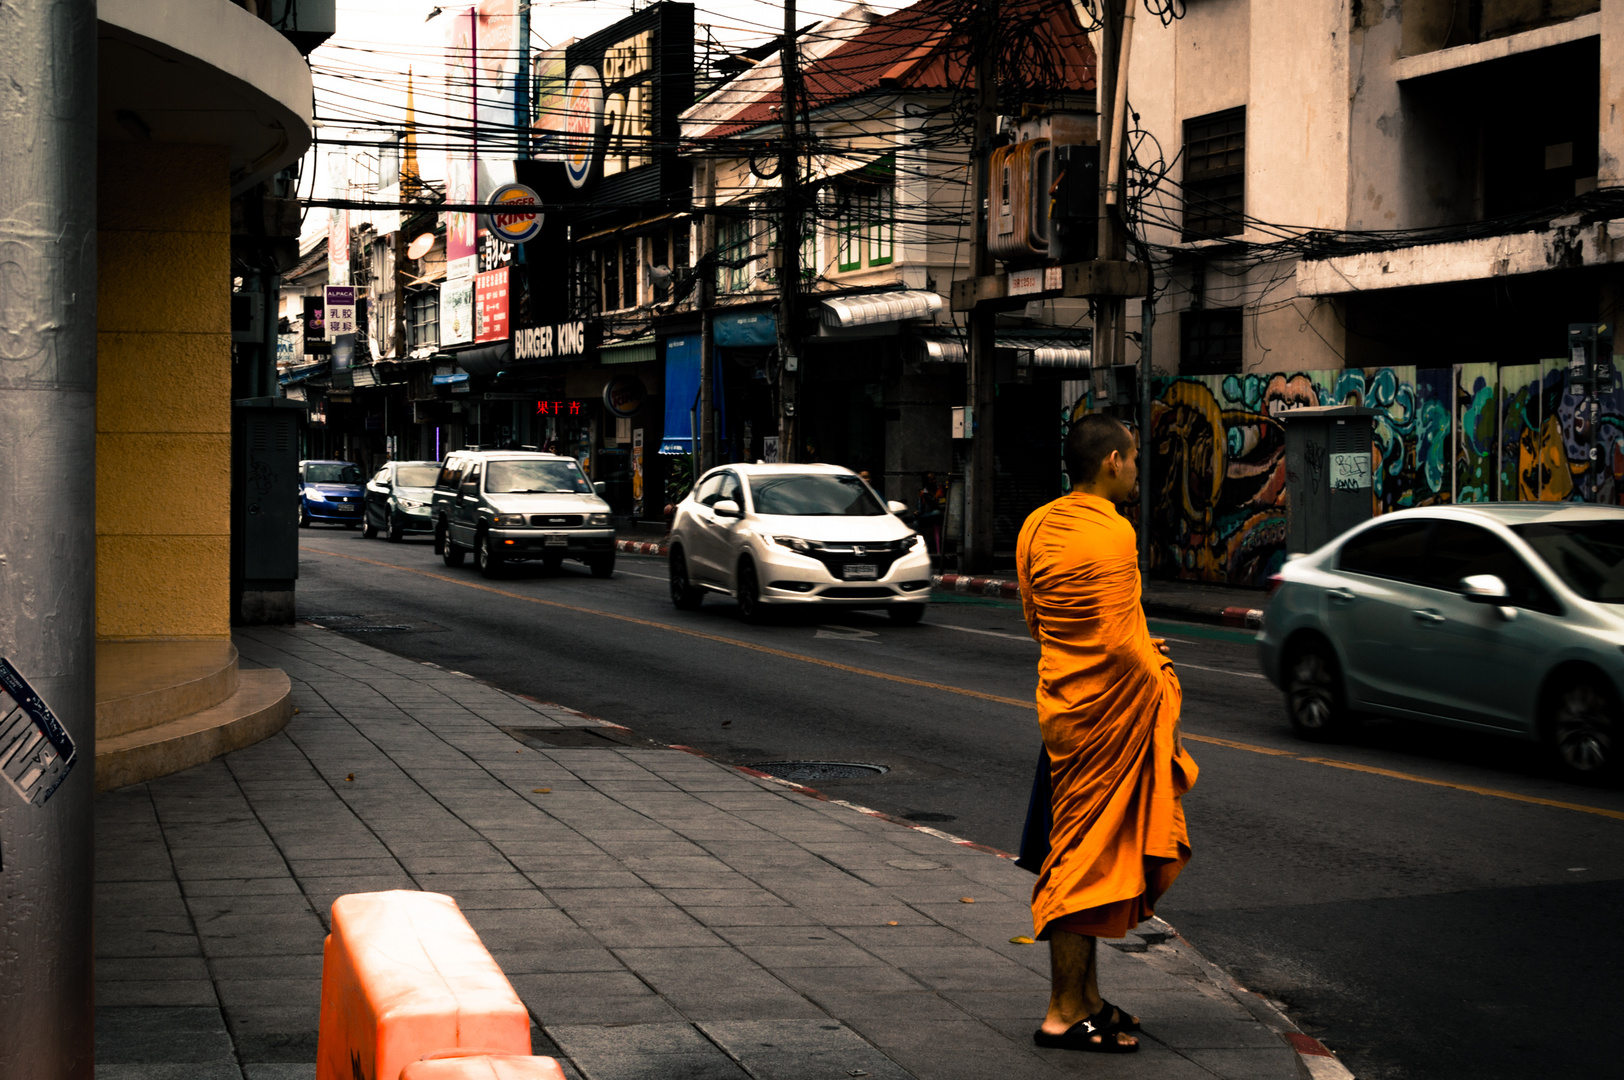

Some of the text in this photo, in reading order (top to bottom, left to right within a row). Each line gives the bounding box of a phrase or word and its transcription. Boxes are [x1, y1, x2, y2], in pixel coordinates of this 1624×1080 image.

[603, 30, 654, 87] OPEN
[604, 86, 643, 178] 24
[514, 321, 584, 360] BURGER KING
